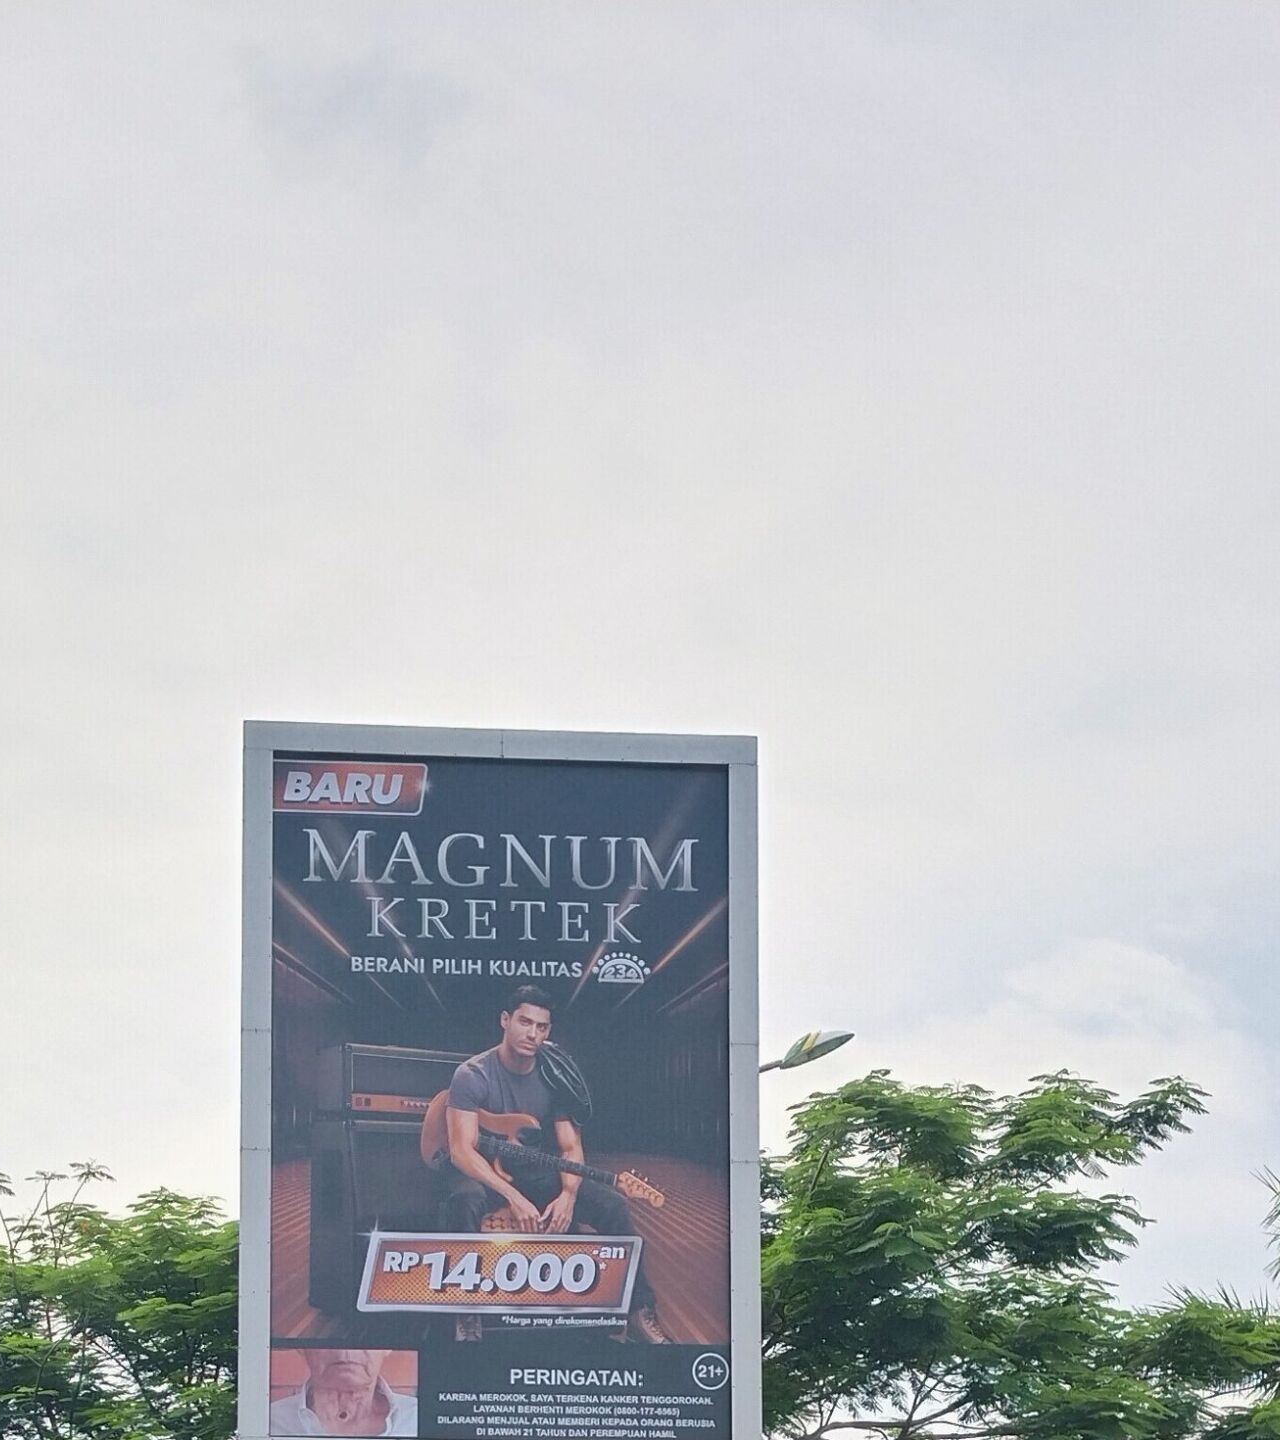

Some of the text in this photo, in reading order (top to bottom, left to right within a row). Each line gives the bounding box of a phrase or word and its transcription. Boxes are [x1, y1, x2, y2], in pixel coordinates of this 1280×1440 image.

[283, 771, 403, 805] BARU
[302, 828, 700, 892] MAGNUM
[366, 896, 642, 944] KRETEK
[351, 957, 424, 974] BERANI
[432, 959, 482, 975] PILIH
[489, 960, 583, 978] KUALITAS
[383, 1251, 420, 1273] RP
[422, 1252, 596, 1293] 14.000
[533, 1317, 553, 1327] yang
[555, 1317, 628, 1327] direkomendasikan
[510, 1369, 644, 1387] PERINGATAN:
[698, 1365, 724, 1379] 21+
[439, 1393, 477, 1401] KARENA
[531, 1394, 554, 1403] SAYA
[556, 1395, 599, 1404] TERKENA
[601, 1396, 638, 1404] KANKER
[473, 1405, 515, 1413] LAYANAN
[517, 1405, 560, 1414] BERHENTI
[561, 1406, 612, 1415] MEROKOK
[437, 1416, 715, 1428] DILARANG MENJUAL ATAU MEMBERI KEPADA ORANG BERUSIA
[476, 1428, 677, 1438] DI BAWAH 21 TAHUN DAN PEREMPUAN HAMIL
